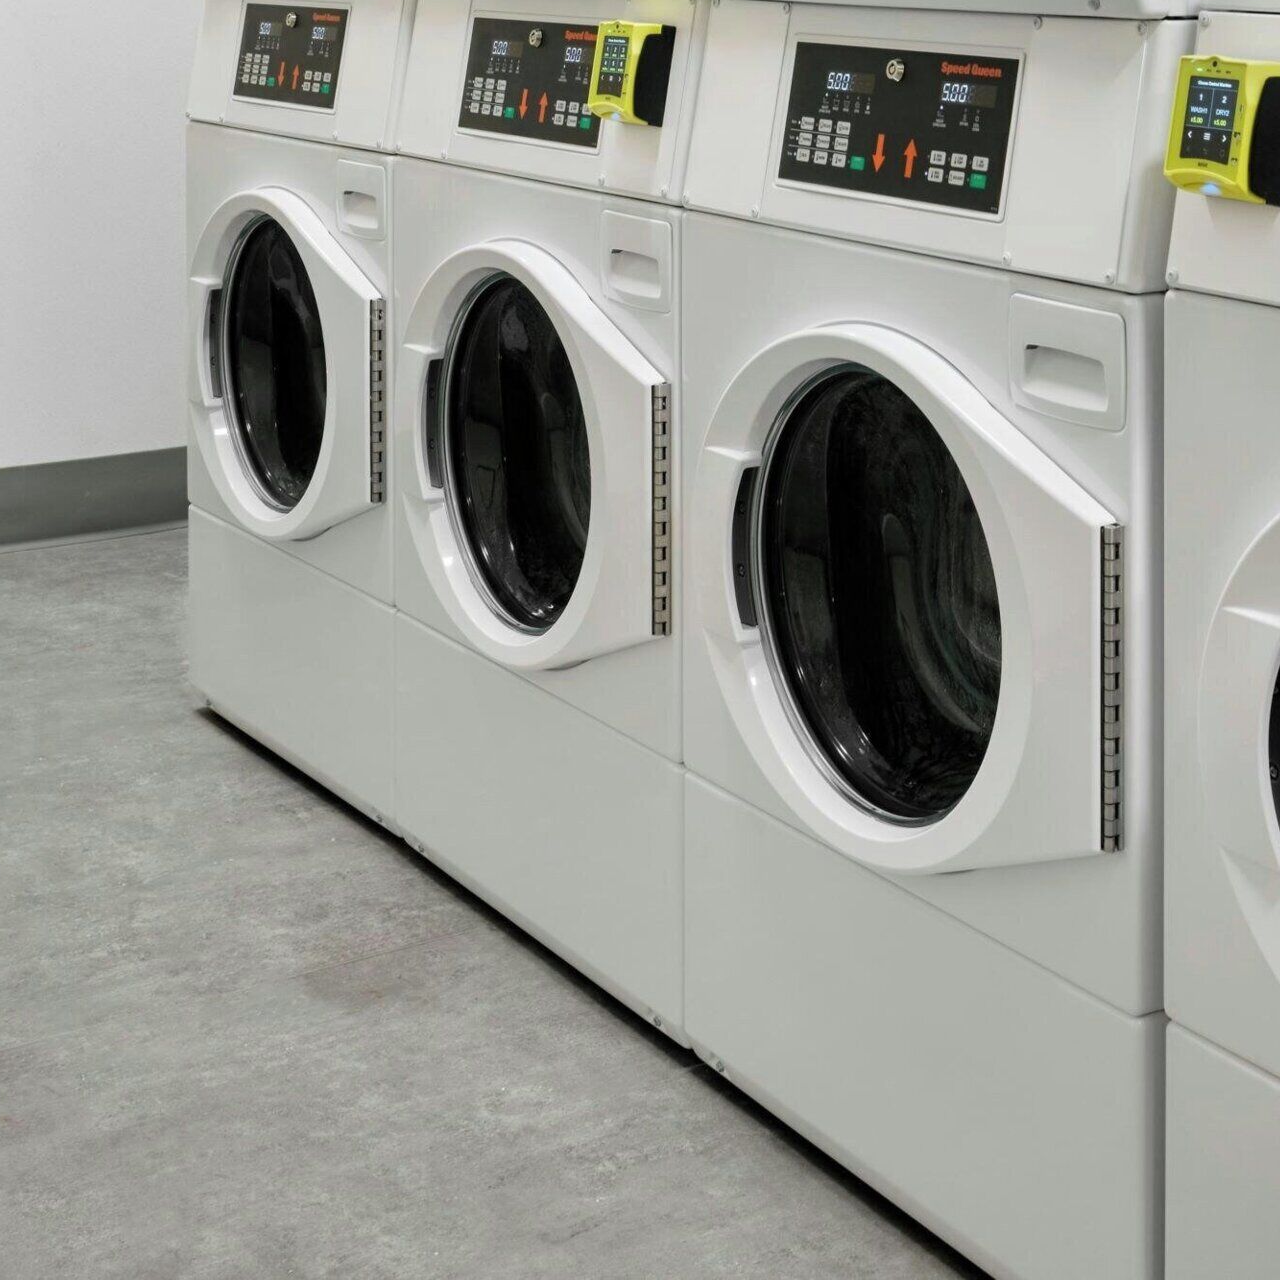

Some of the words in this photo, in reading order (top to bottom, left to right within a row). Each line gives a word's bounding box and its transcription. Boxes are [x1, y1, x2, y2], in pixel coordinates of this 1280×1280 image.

[564, 30, 584, 41] Speed
[940, 61, 970, 78] Speed
[970, 63, 1002, 78] Queen
[826, 72, 850, 91] 5.00
[940, 83, 968, 103] 5.00
